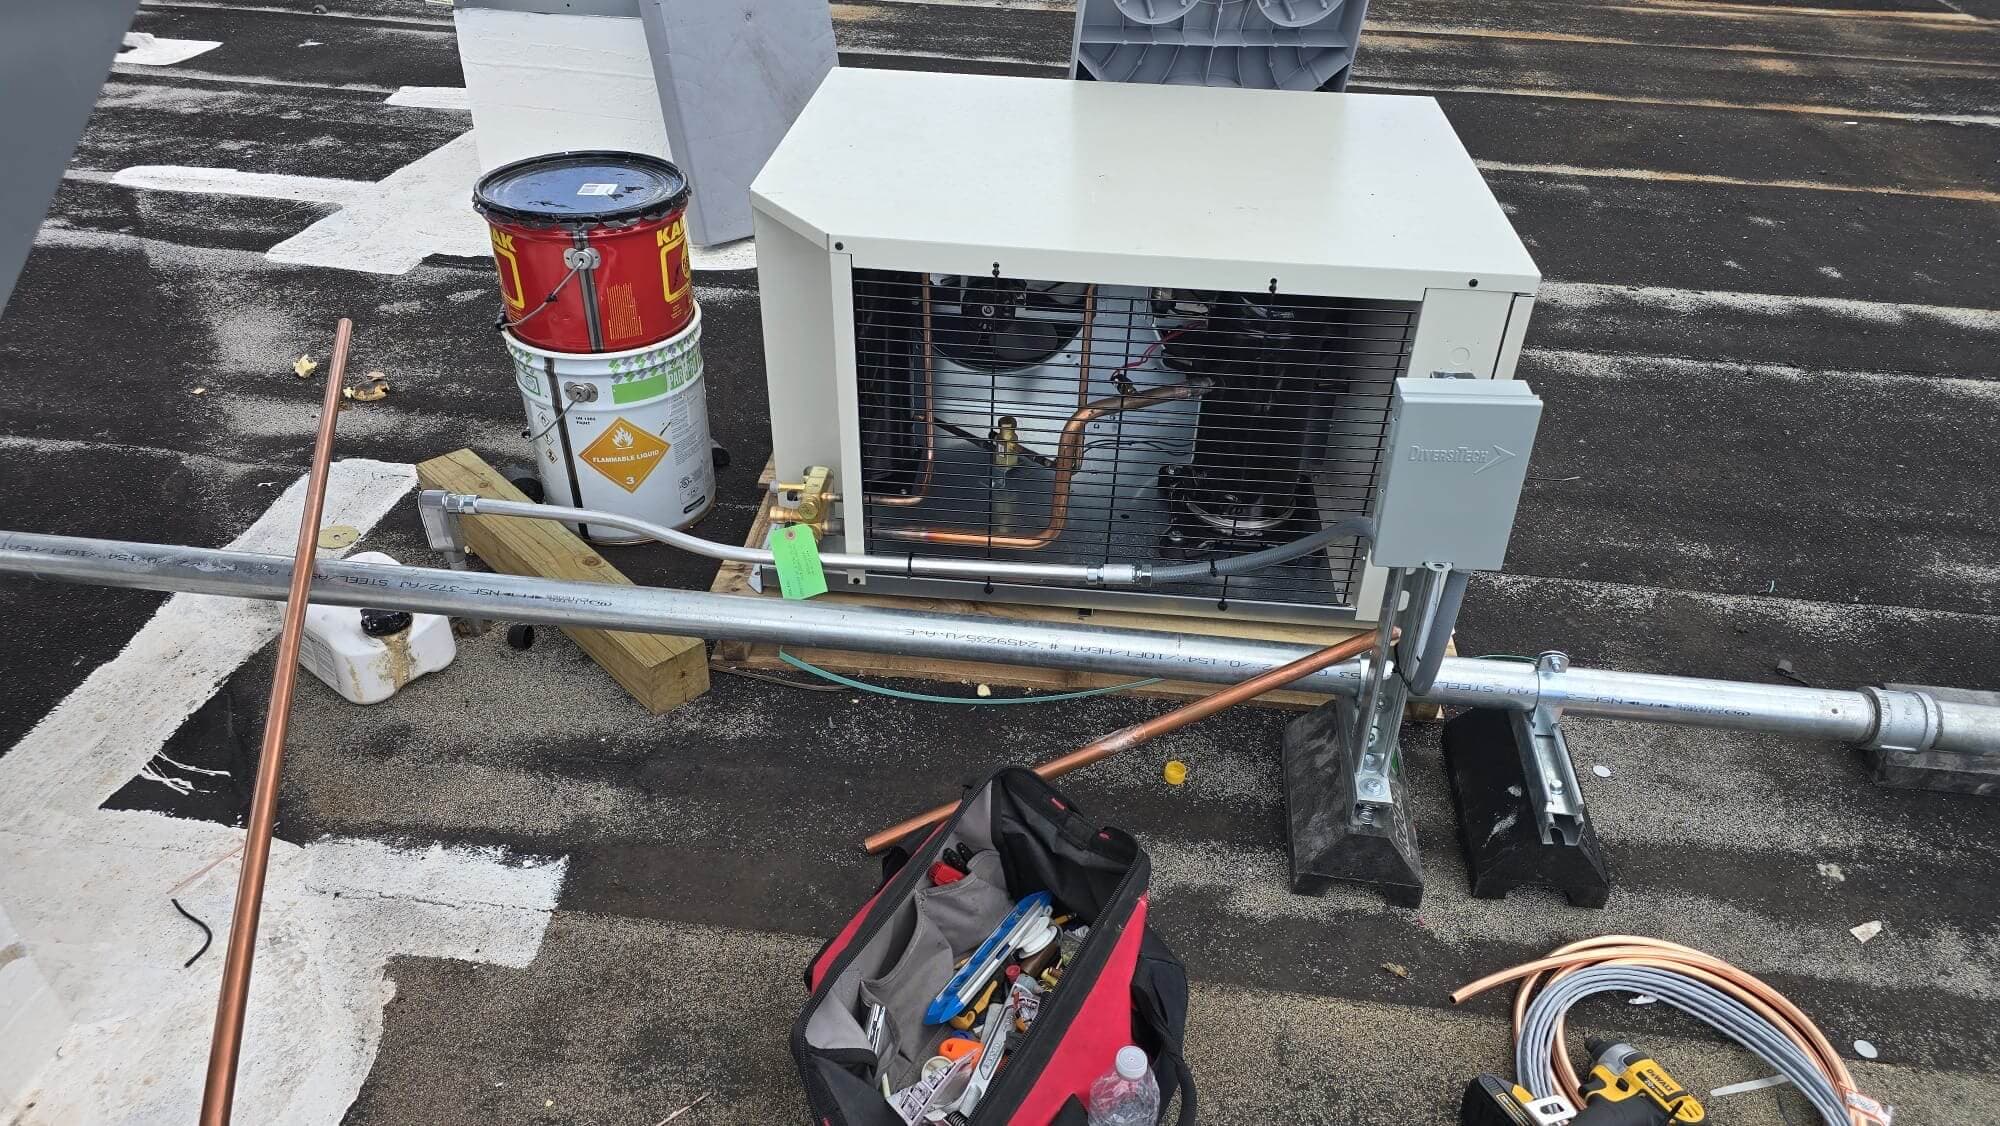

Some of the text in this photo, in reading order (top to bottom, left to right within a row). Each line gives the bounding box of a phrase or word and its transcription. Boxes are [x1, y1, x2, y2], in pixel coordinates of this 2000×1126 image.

[592, 449, 660, 464] FLAMMABLE LIQUID
[625, 476, 636, 485] 3
